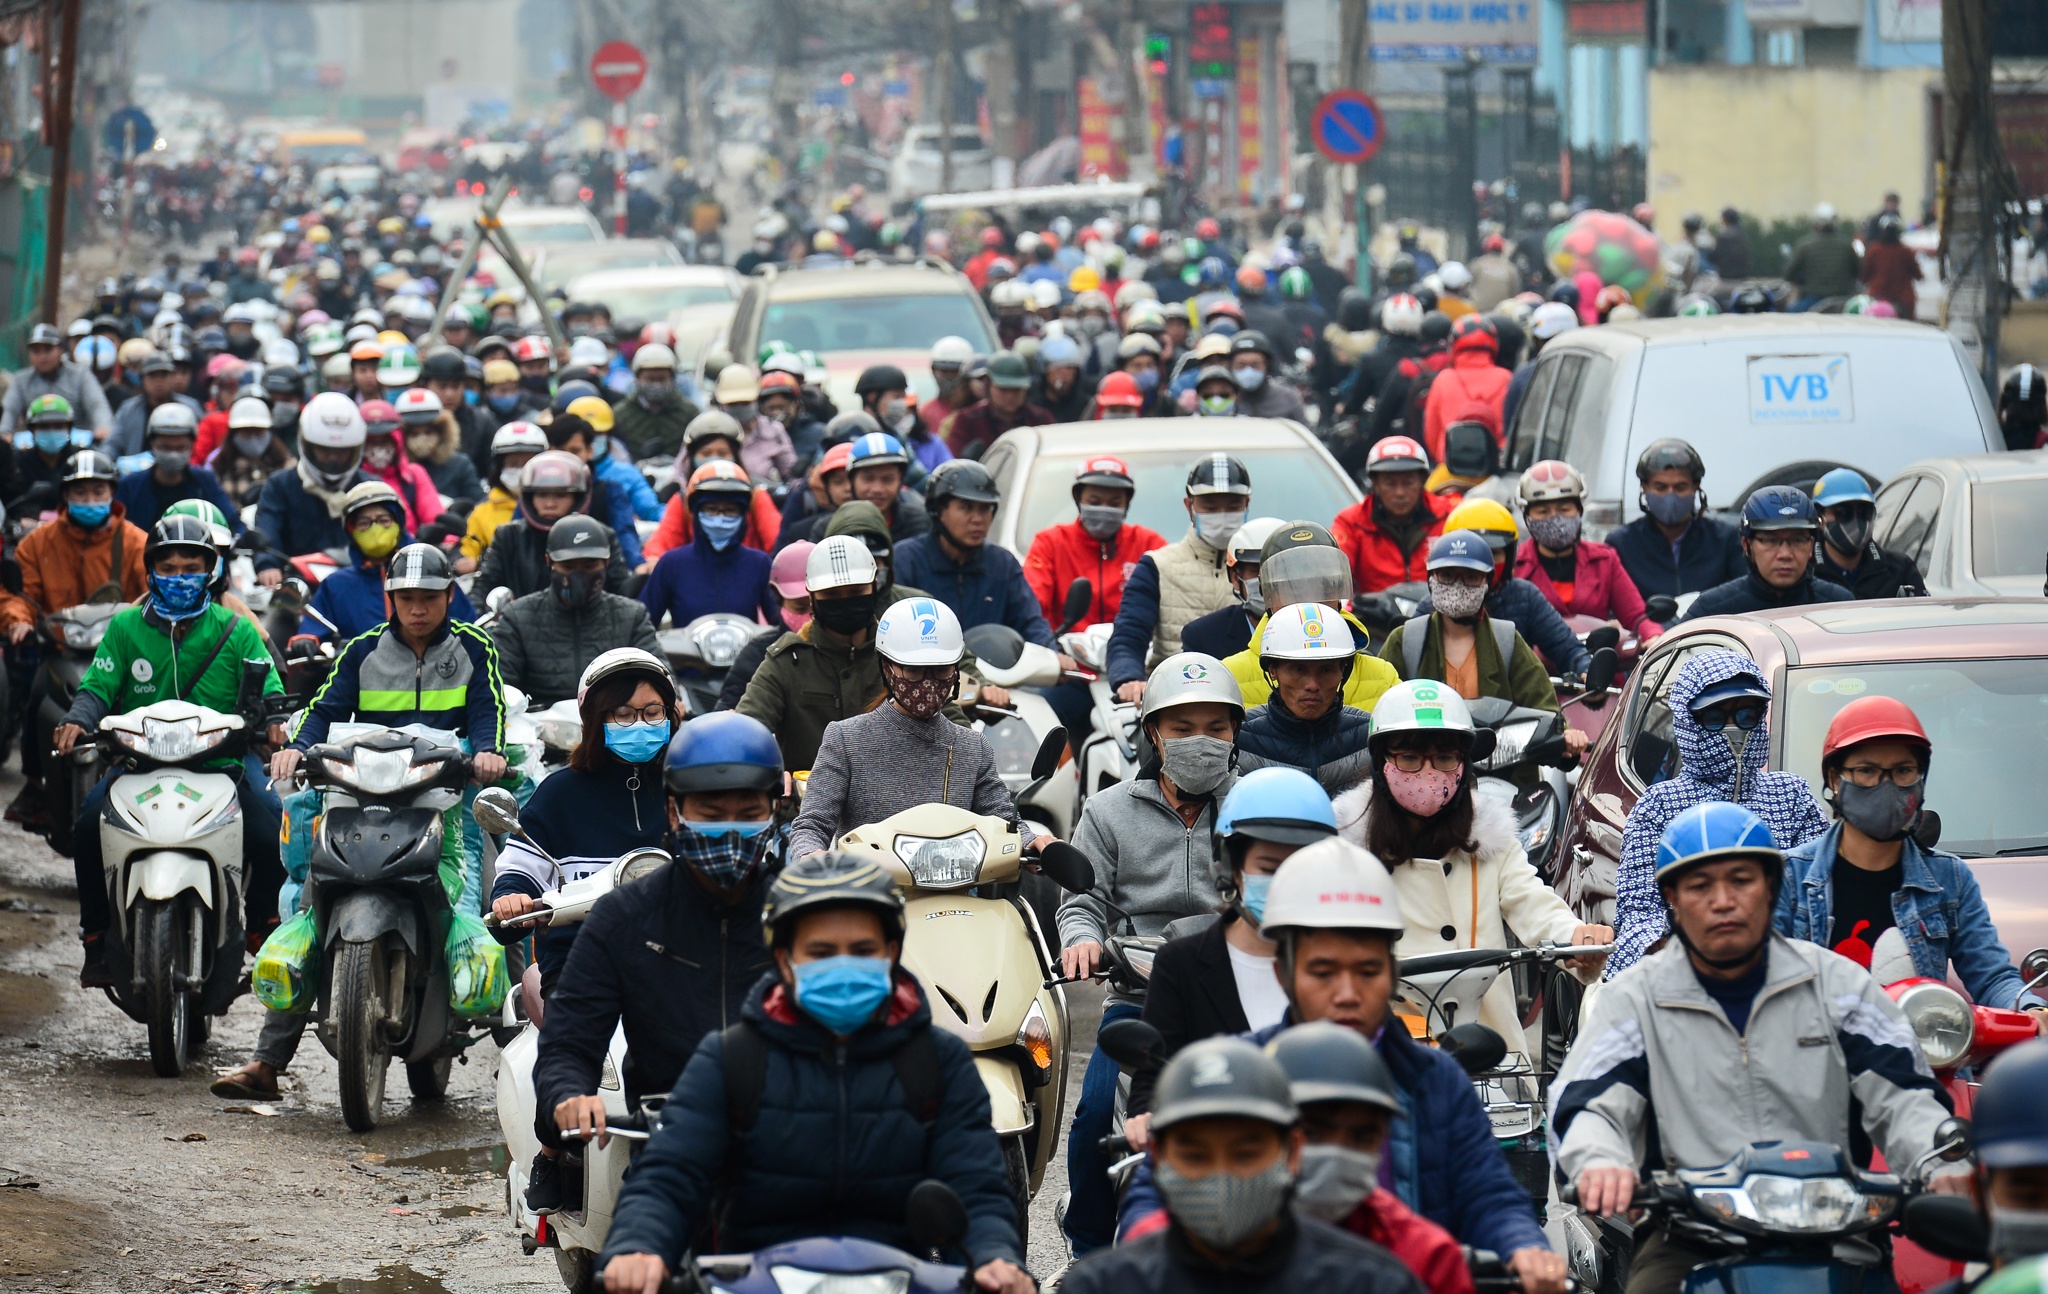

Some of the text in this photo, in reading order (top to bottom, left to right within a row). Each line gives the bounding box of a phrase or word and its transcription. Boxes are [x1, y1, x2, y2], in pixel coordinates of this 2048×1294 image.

[1761, 373, 1829, 402] IVB
[93, 656, 115, 672] rab
[134, 684, 156, 694] Grab
[925, 910, 974, 920] HONDA
